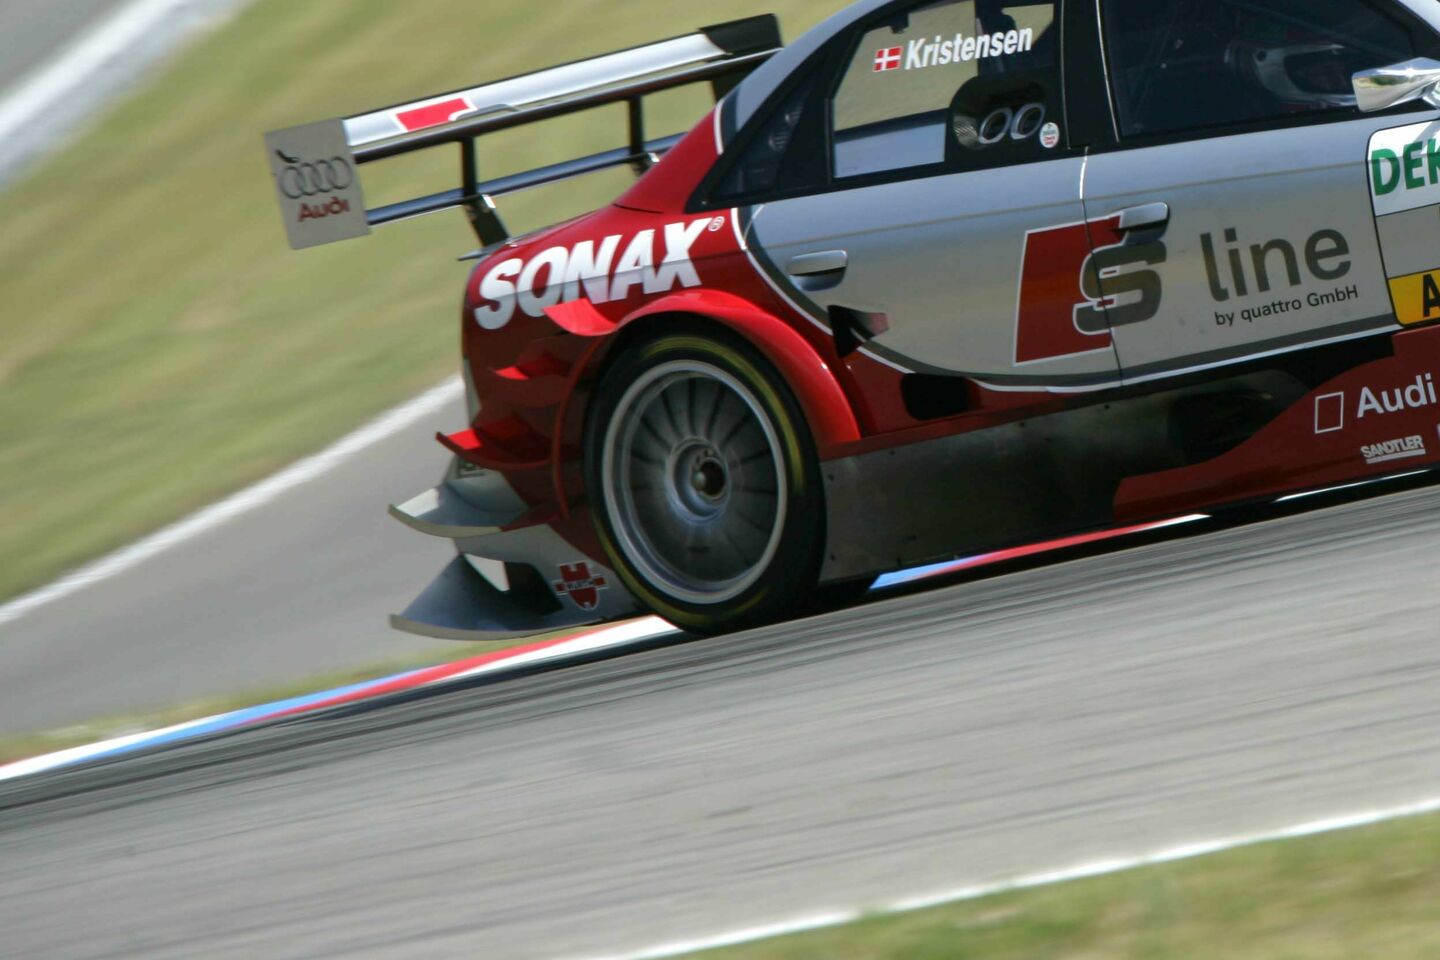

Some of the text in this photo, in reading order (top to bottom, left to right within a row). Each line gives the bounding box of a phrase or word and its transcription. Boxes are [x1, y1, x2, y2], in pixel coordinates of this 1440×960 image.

[904, 27, 1033, 70] Kristensen
[298, 196, 351, 222] Audi
[1200, 227, 1352, 302] line
[1214, 285, 1360, 328] by quattro GmbH
[1356, 373, 1438, 419] Audi
[1360, 435, 1425, 459] SANDTLER
